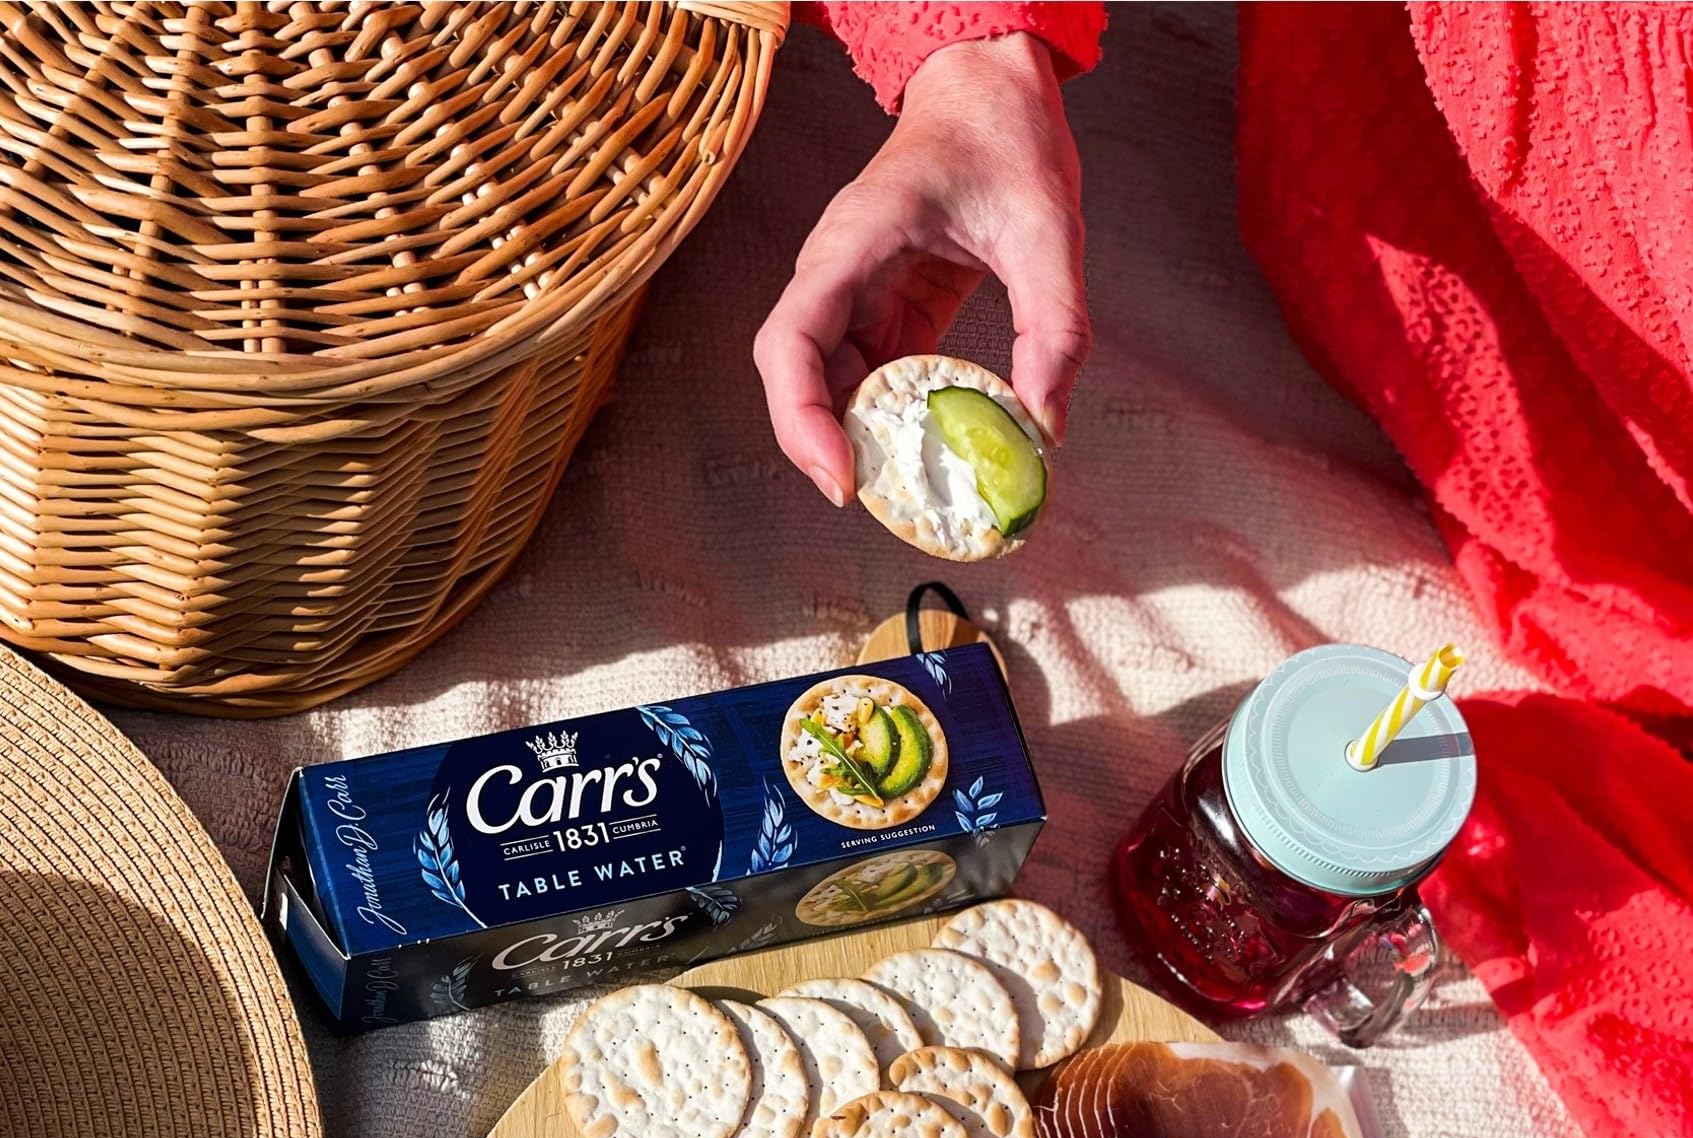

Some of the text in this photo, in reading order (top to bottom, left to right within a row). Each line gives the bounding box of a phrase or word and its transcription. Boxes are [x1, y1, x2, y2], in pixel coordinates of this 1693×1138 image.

[325, 774, 367, 821] Carr
[466, 756, 662, 835] Carr's
[503, 819, 659, 856] CARLISLE 1831 CUMBRIA
[840, 824, 937, 849] SERVING SUGGESTION
[345, 845, 408, 936] Jonathan
[498, 850, 685, 900] TABLE WATER
[491, 914, 689, 972] Carr's
[562, 950, 614, 970] 1831
[493, 955, 670, 998] TABLE WATER
